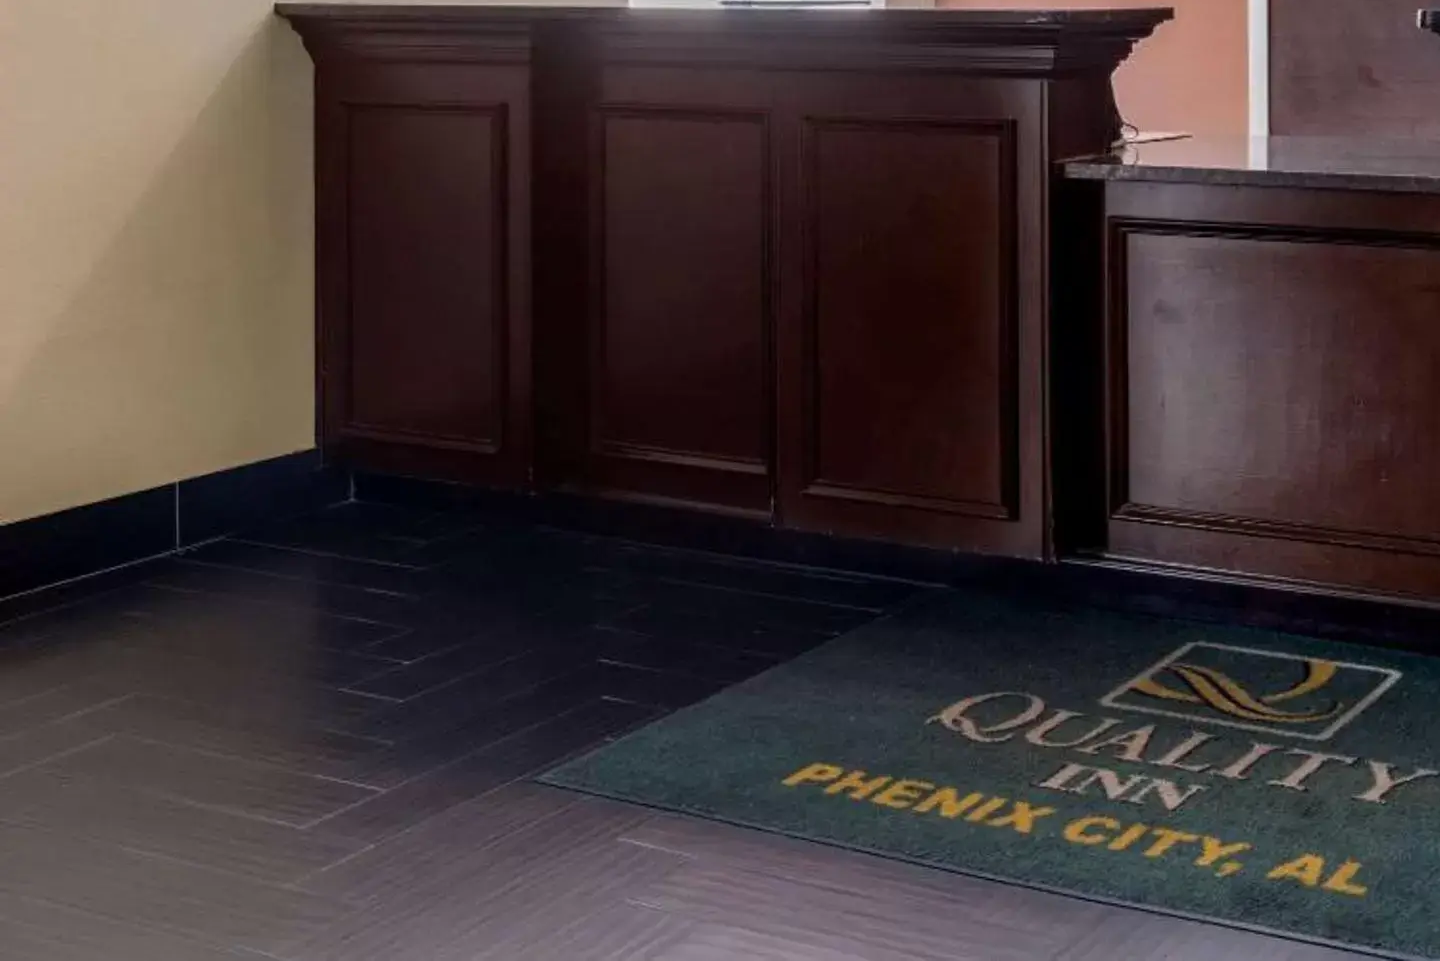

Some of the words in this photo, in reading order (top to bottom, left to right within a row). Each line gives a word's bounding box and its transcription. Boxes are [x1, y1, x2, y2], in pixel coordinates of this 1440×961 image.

[927, 691, 1439, 804] QUALITY
[1034, 762, 1205, 811] INN
[781, 763, 1057, 835] PHENIX
[1063, 816, 1254, 878] CITY,
[1266, 853, 1369, 896] AL
